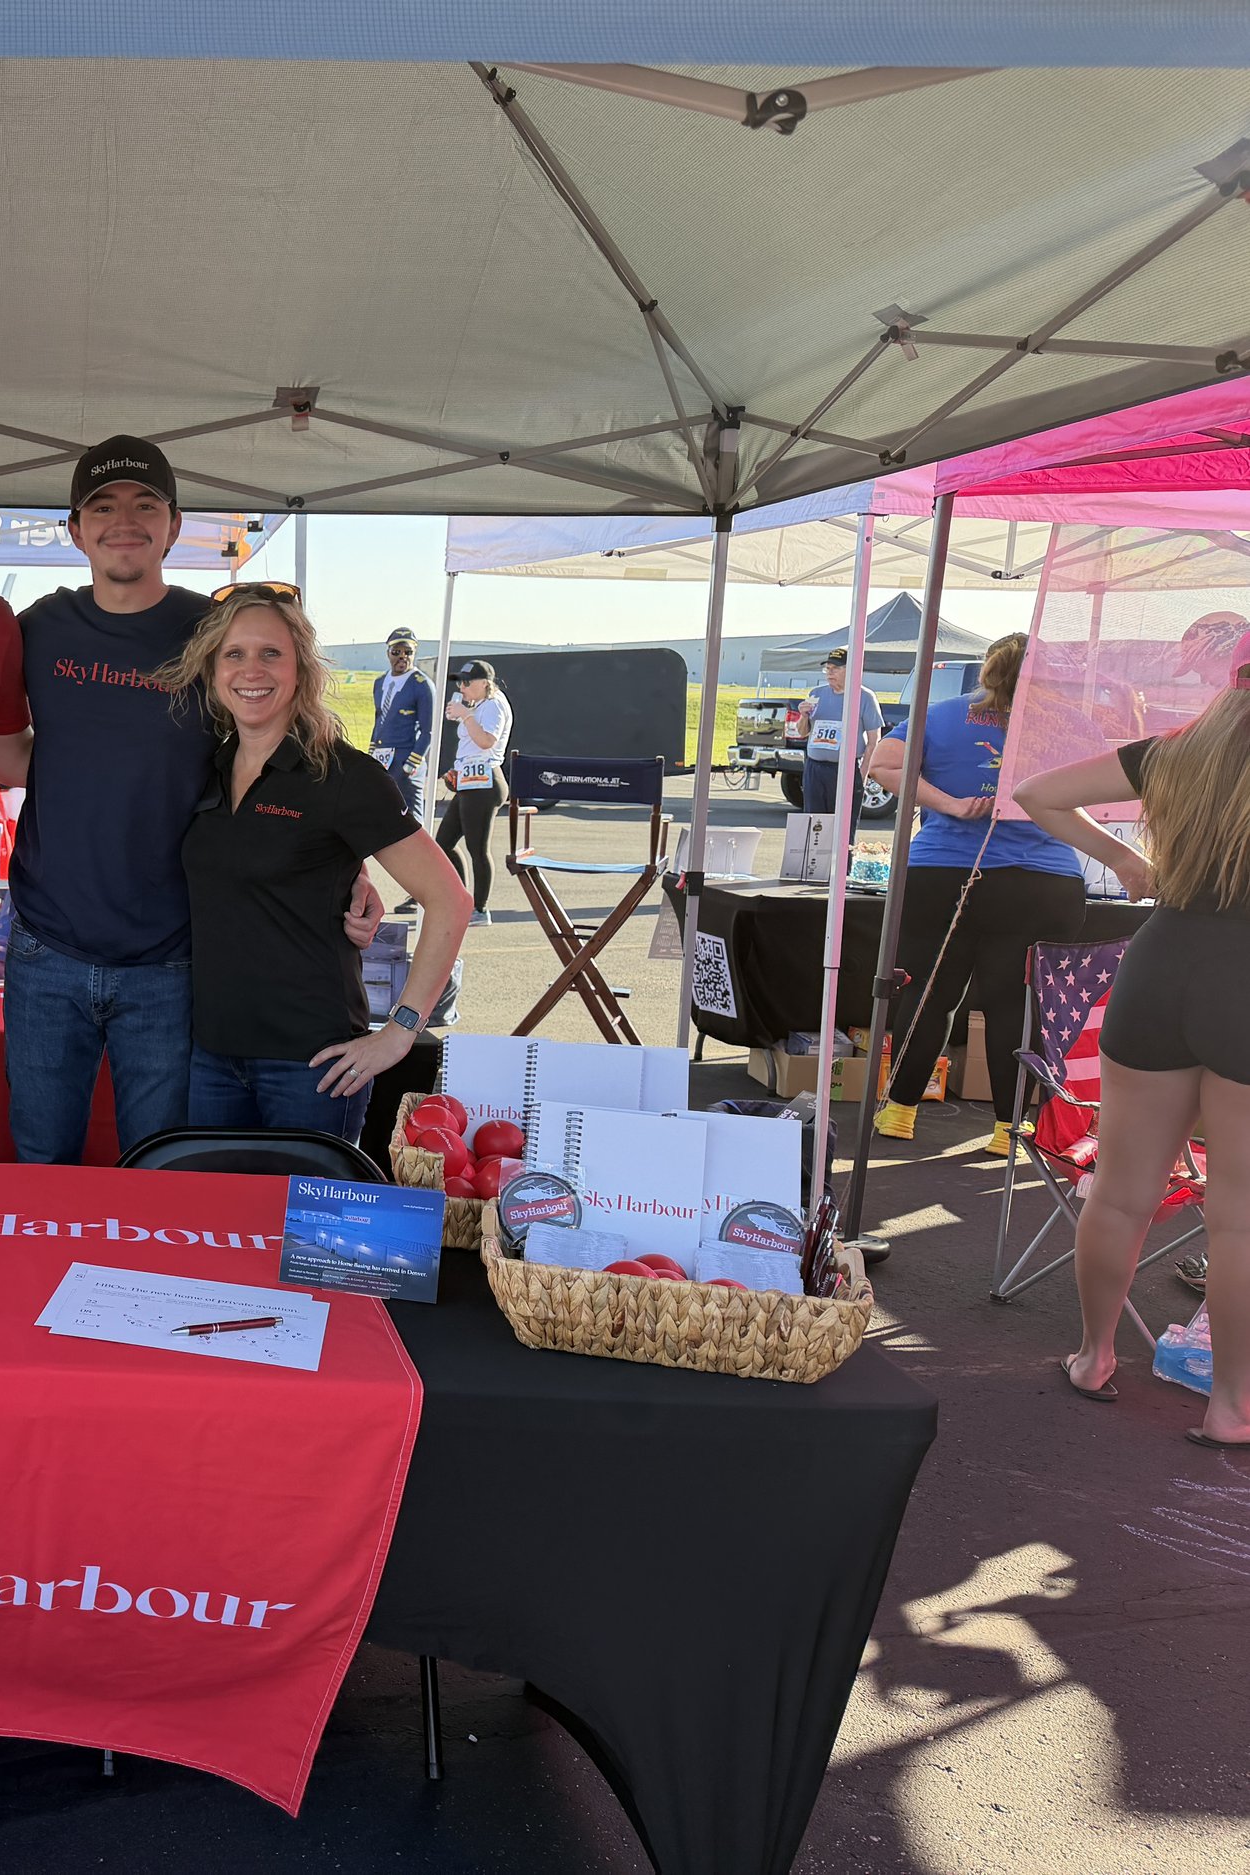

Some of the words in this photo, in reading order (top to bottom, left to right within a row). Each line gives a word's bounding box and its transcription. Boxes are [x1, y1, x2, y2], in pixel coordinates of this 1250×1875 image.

[90, 457, 150, 477] SkyHarbour
[817, 728, 837, 740] 518
[463, 763, 485, 777] 318
[561, 775, 609, 784] INTERNATIONAL
[255, 803, 303, 819] SkyHarbour
[298, 1182, 380, 1204] SkyHarbour
[509, 1200, 569, 1221] SkyHarbour
[582, 1189, 699, 1220] SkyHarbour
[732, 1227, 796, 1253] SkyHarbour
[307, 1256, 331, 1265] approach
[337, 1260, 353, 1268] Home
[353, 1262, 371, 1271] Basing
[381, 1266, 401, 1274] arrived
[407, 1269, 428, 1278] Denver.
[218, 1299, 253, 1307] private
[256, 1304, 301, 1313] aviation.
